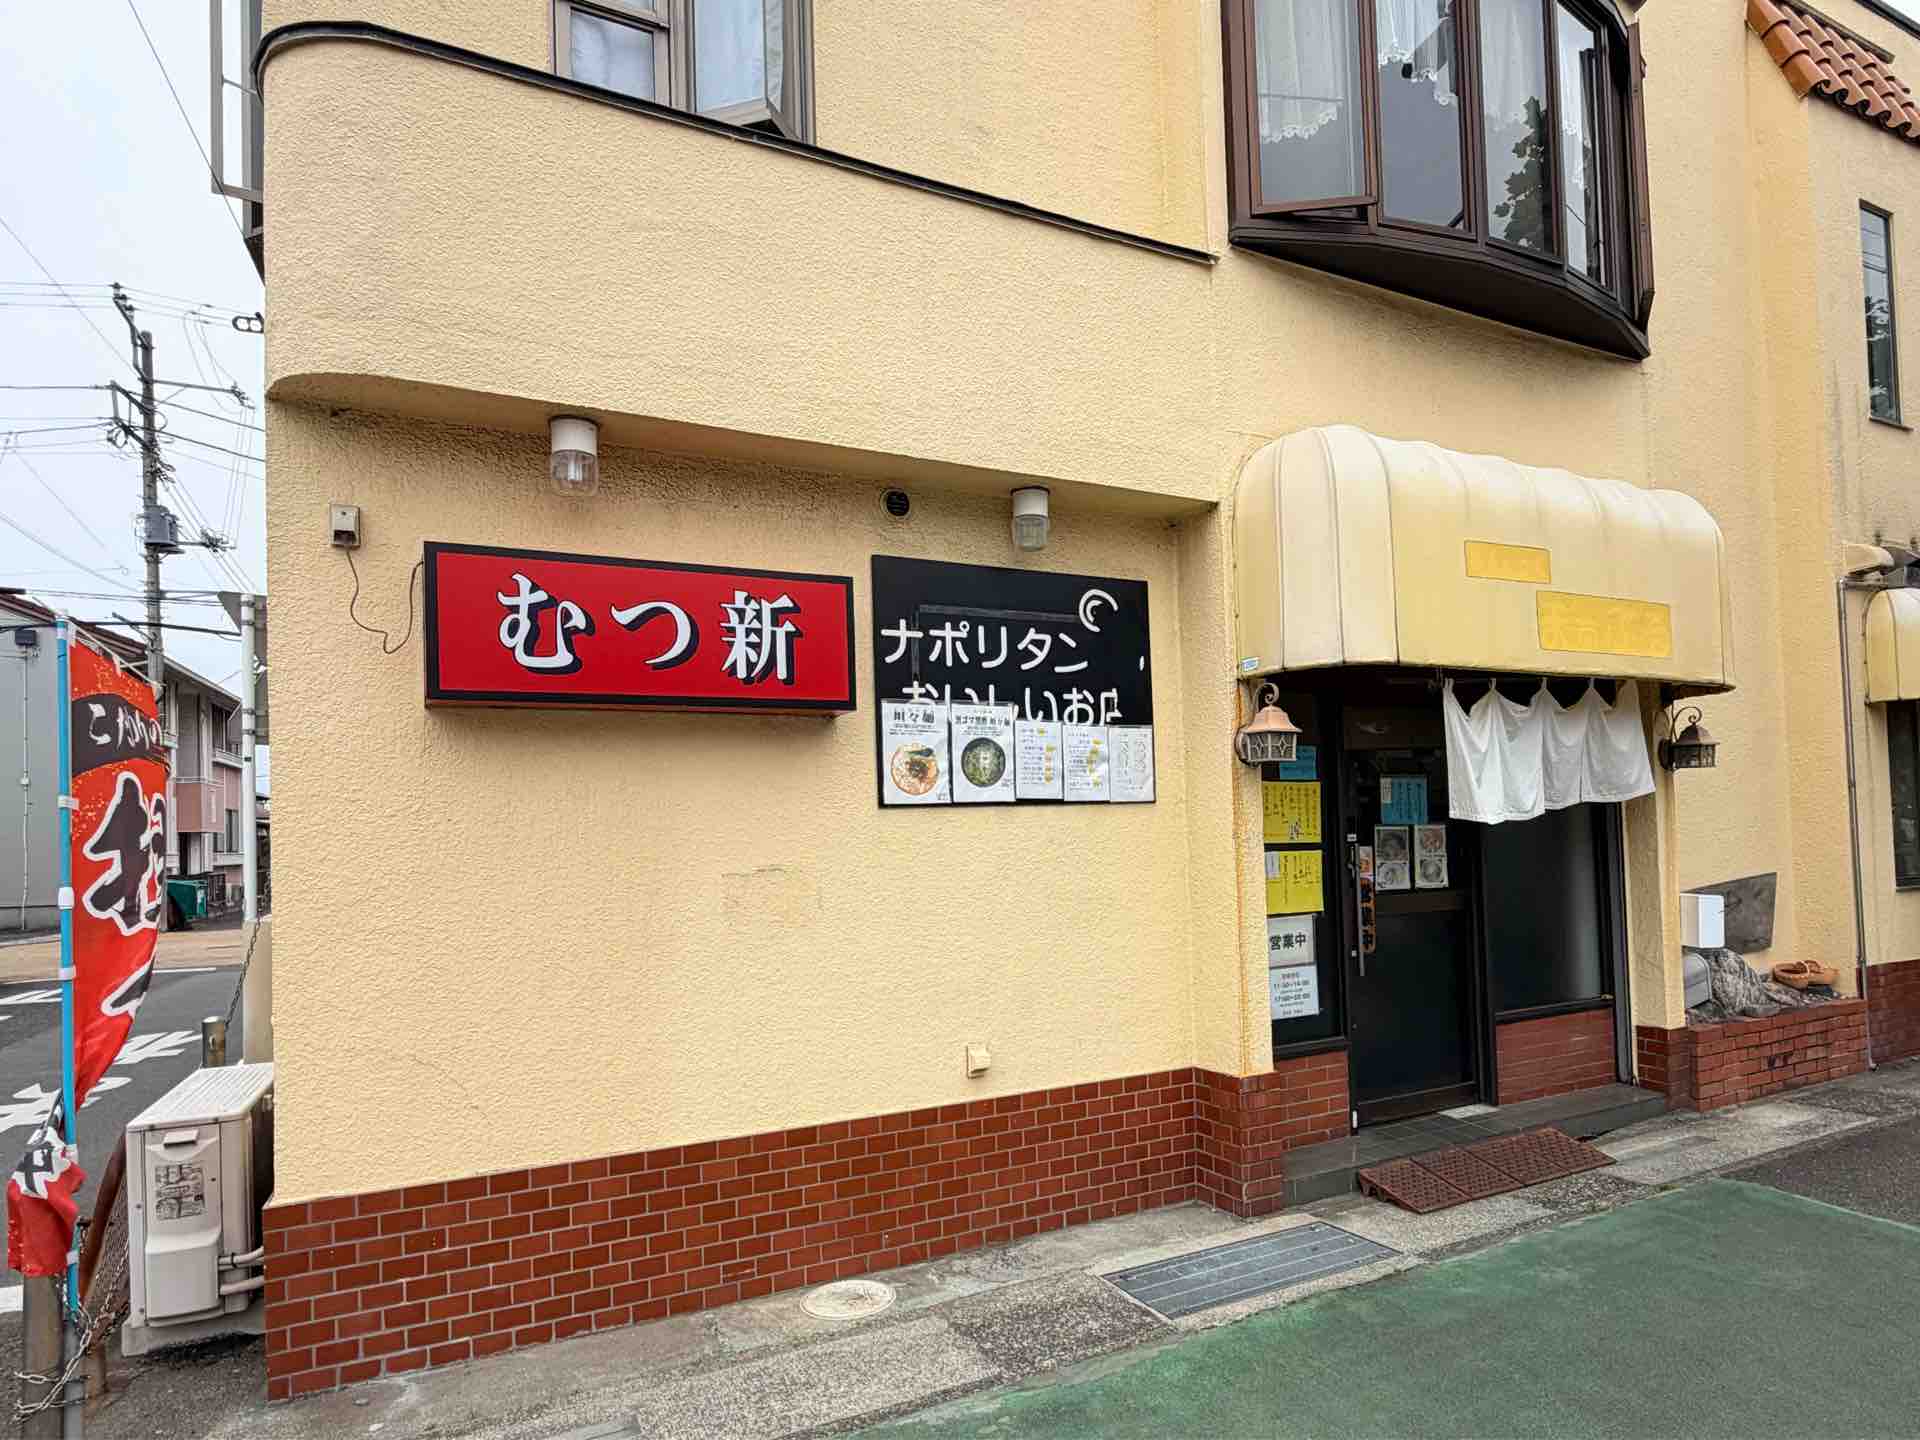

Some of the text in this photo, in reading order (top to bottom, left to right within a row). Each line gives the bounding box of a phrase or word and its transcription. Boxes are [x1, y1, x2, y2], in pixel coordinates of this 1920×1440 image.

[496, 572, 802, 684] むつ新
[880, 618, 1089, 673] ナポリタン
[1269, 931, 1306, 951] 営業中
